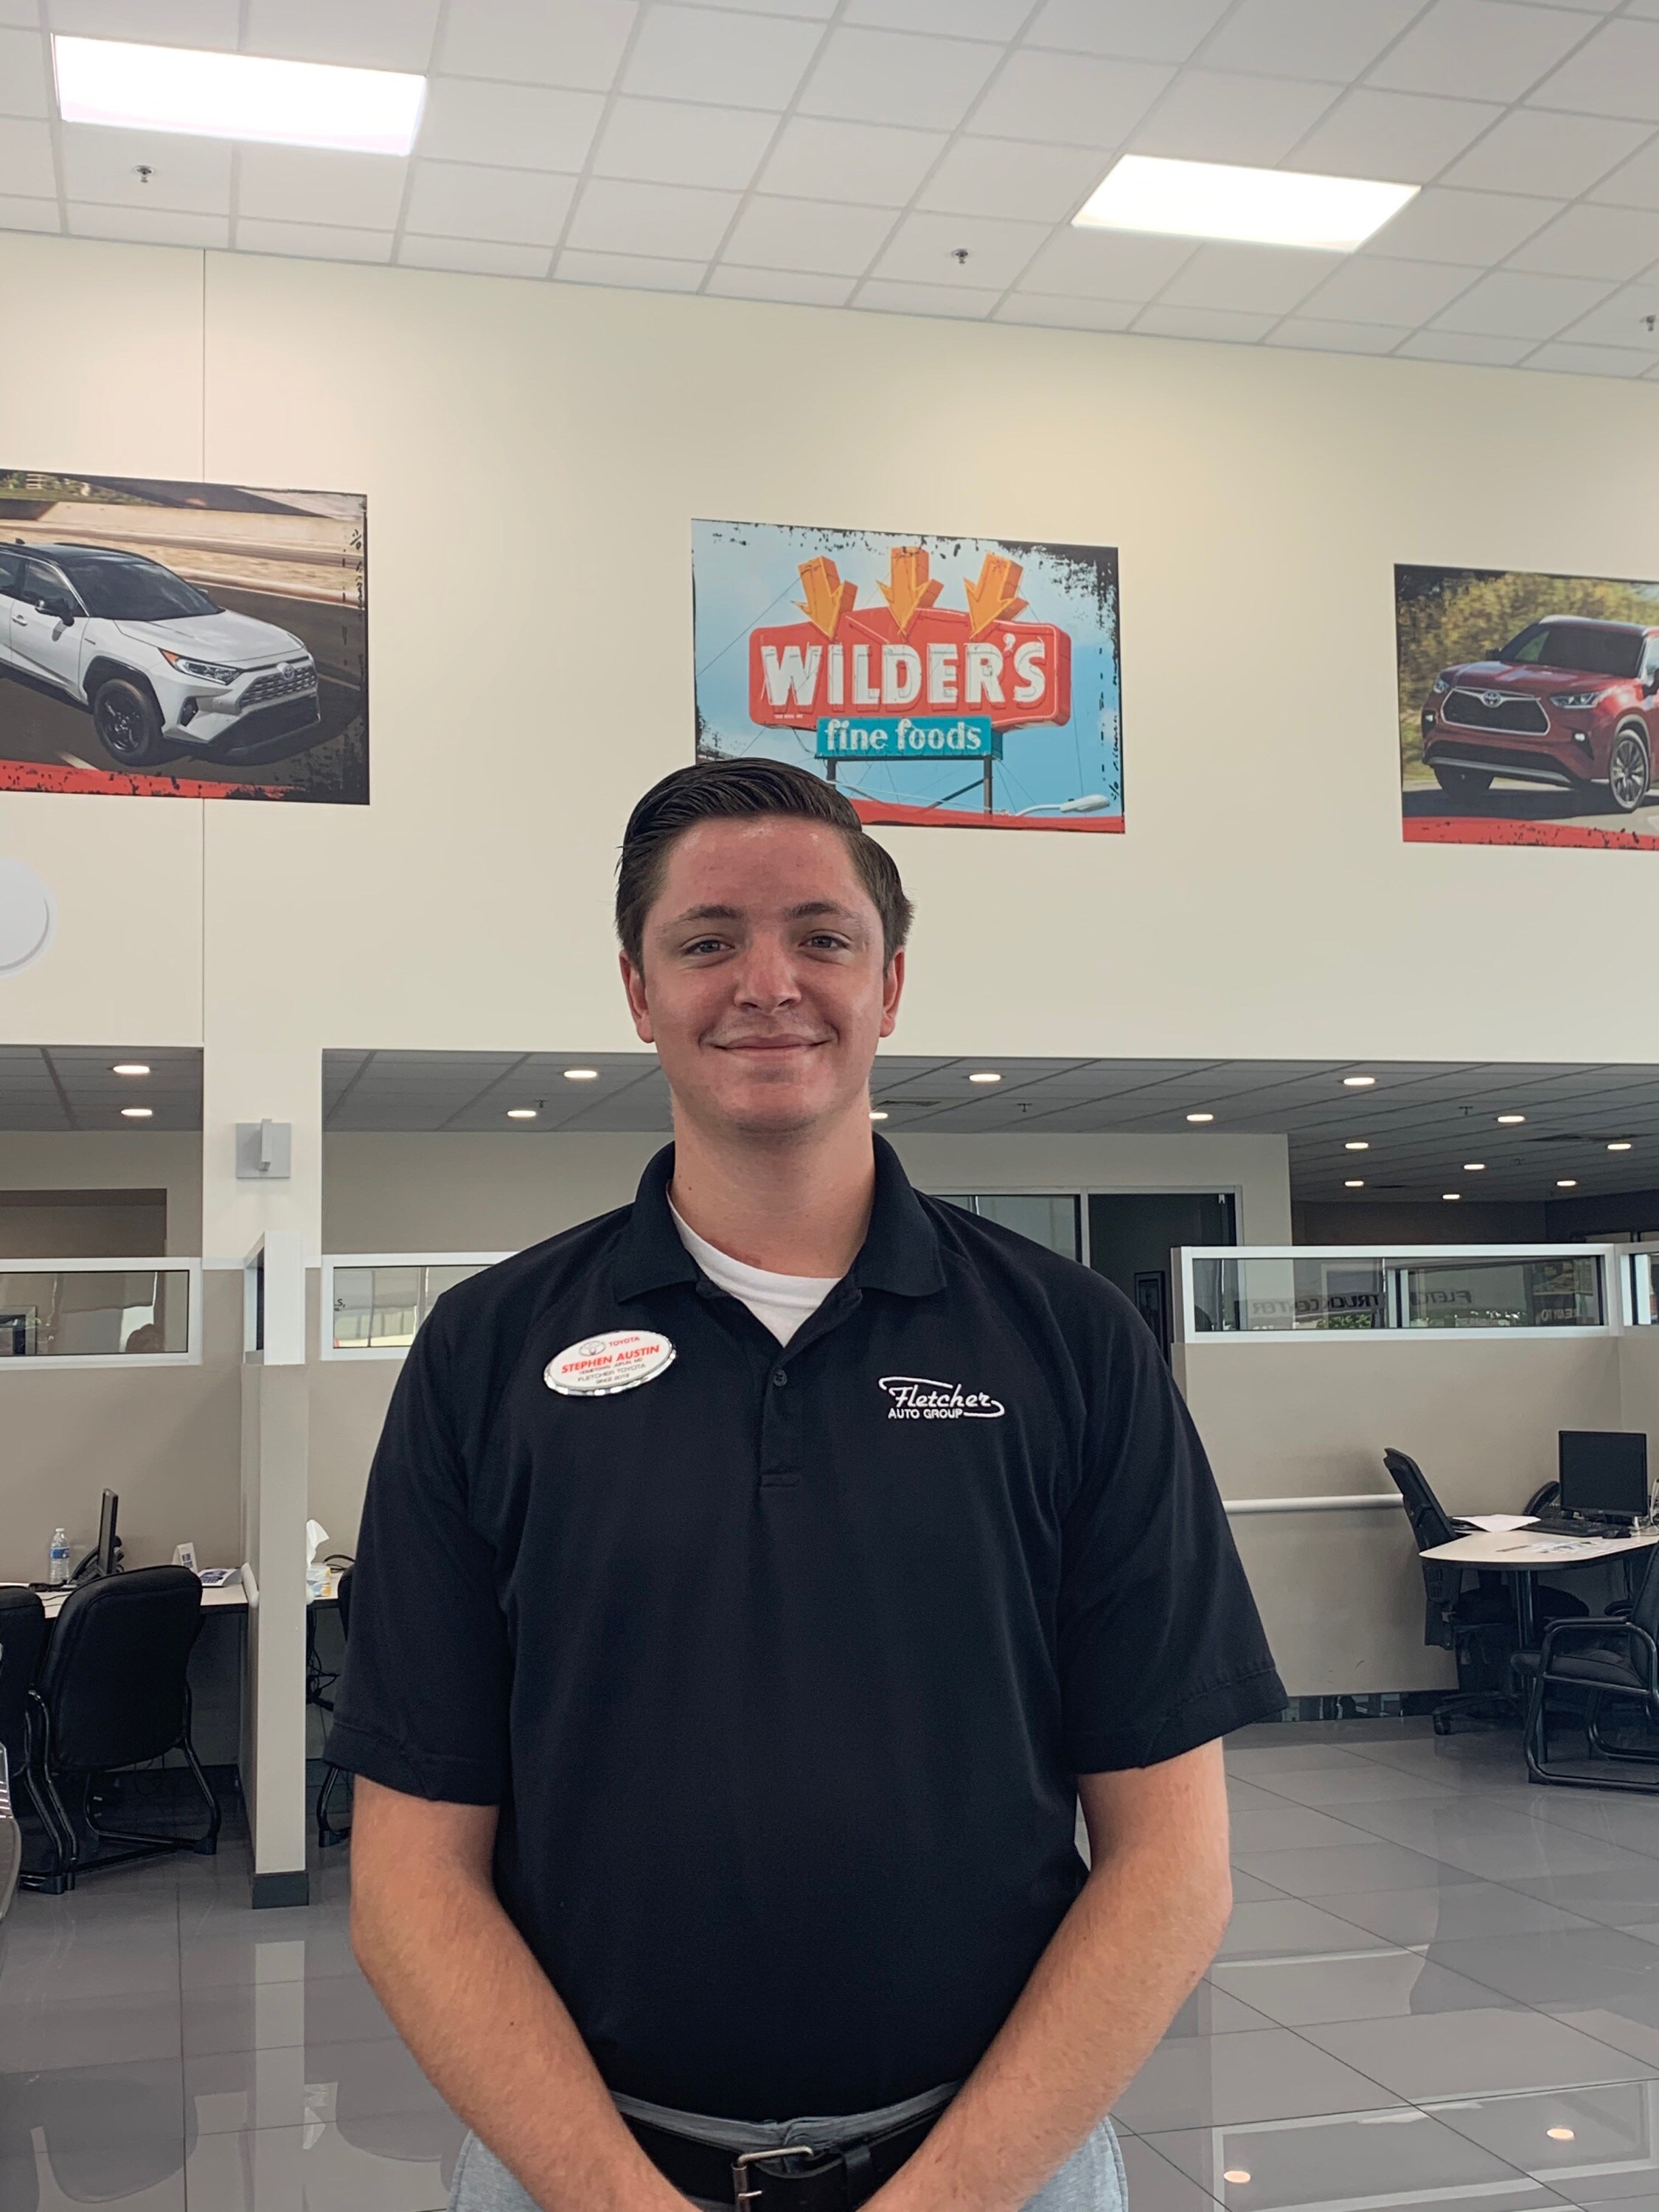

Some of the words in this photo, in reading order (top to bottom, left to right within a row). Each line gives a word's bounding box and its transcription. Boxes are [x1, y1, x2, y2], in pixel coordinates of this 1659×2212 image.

[761, 633, 1046, 706] WILDER'S
[824, 718, 889, 751] fine
[894, 718, 982, 751] foods
[609, 1336, 640, 1346] TOYOTA
[562, 1355, 612, 1373] STEPHEN
[616, 1345, 660, 1361] AUSTIN
[577, 1370, 615, 1381] FLETCHER
[617, 1363, 646, 1373] TOYOTA
[888, 1383, 992, 1408] Fletcher
[888, 1408, 919, 1419] AUTO
[923, 1408, 963, 1419] GROUP
